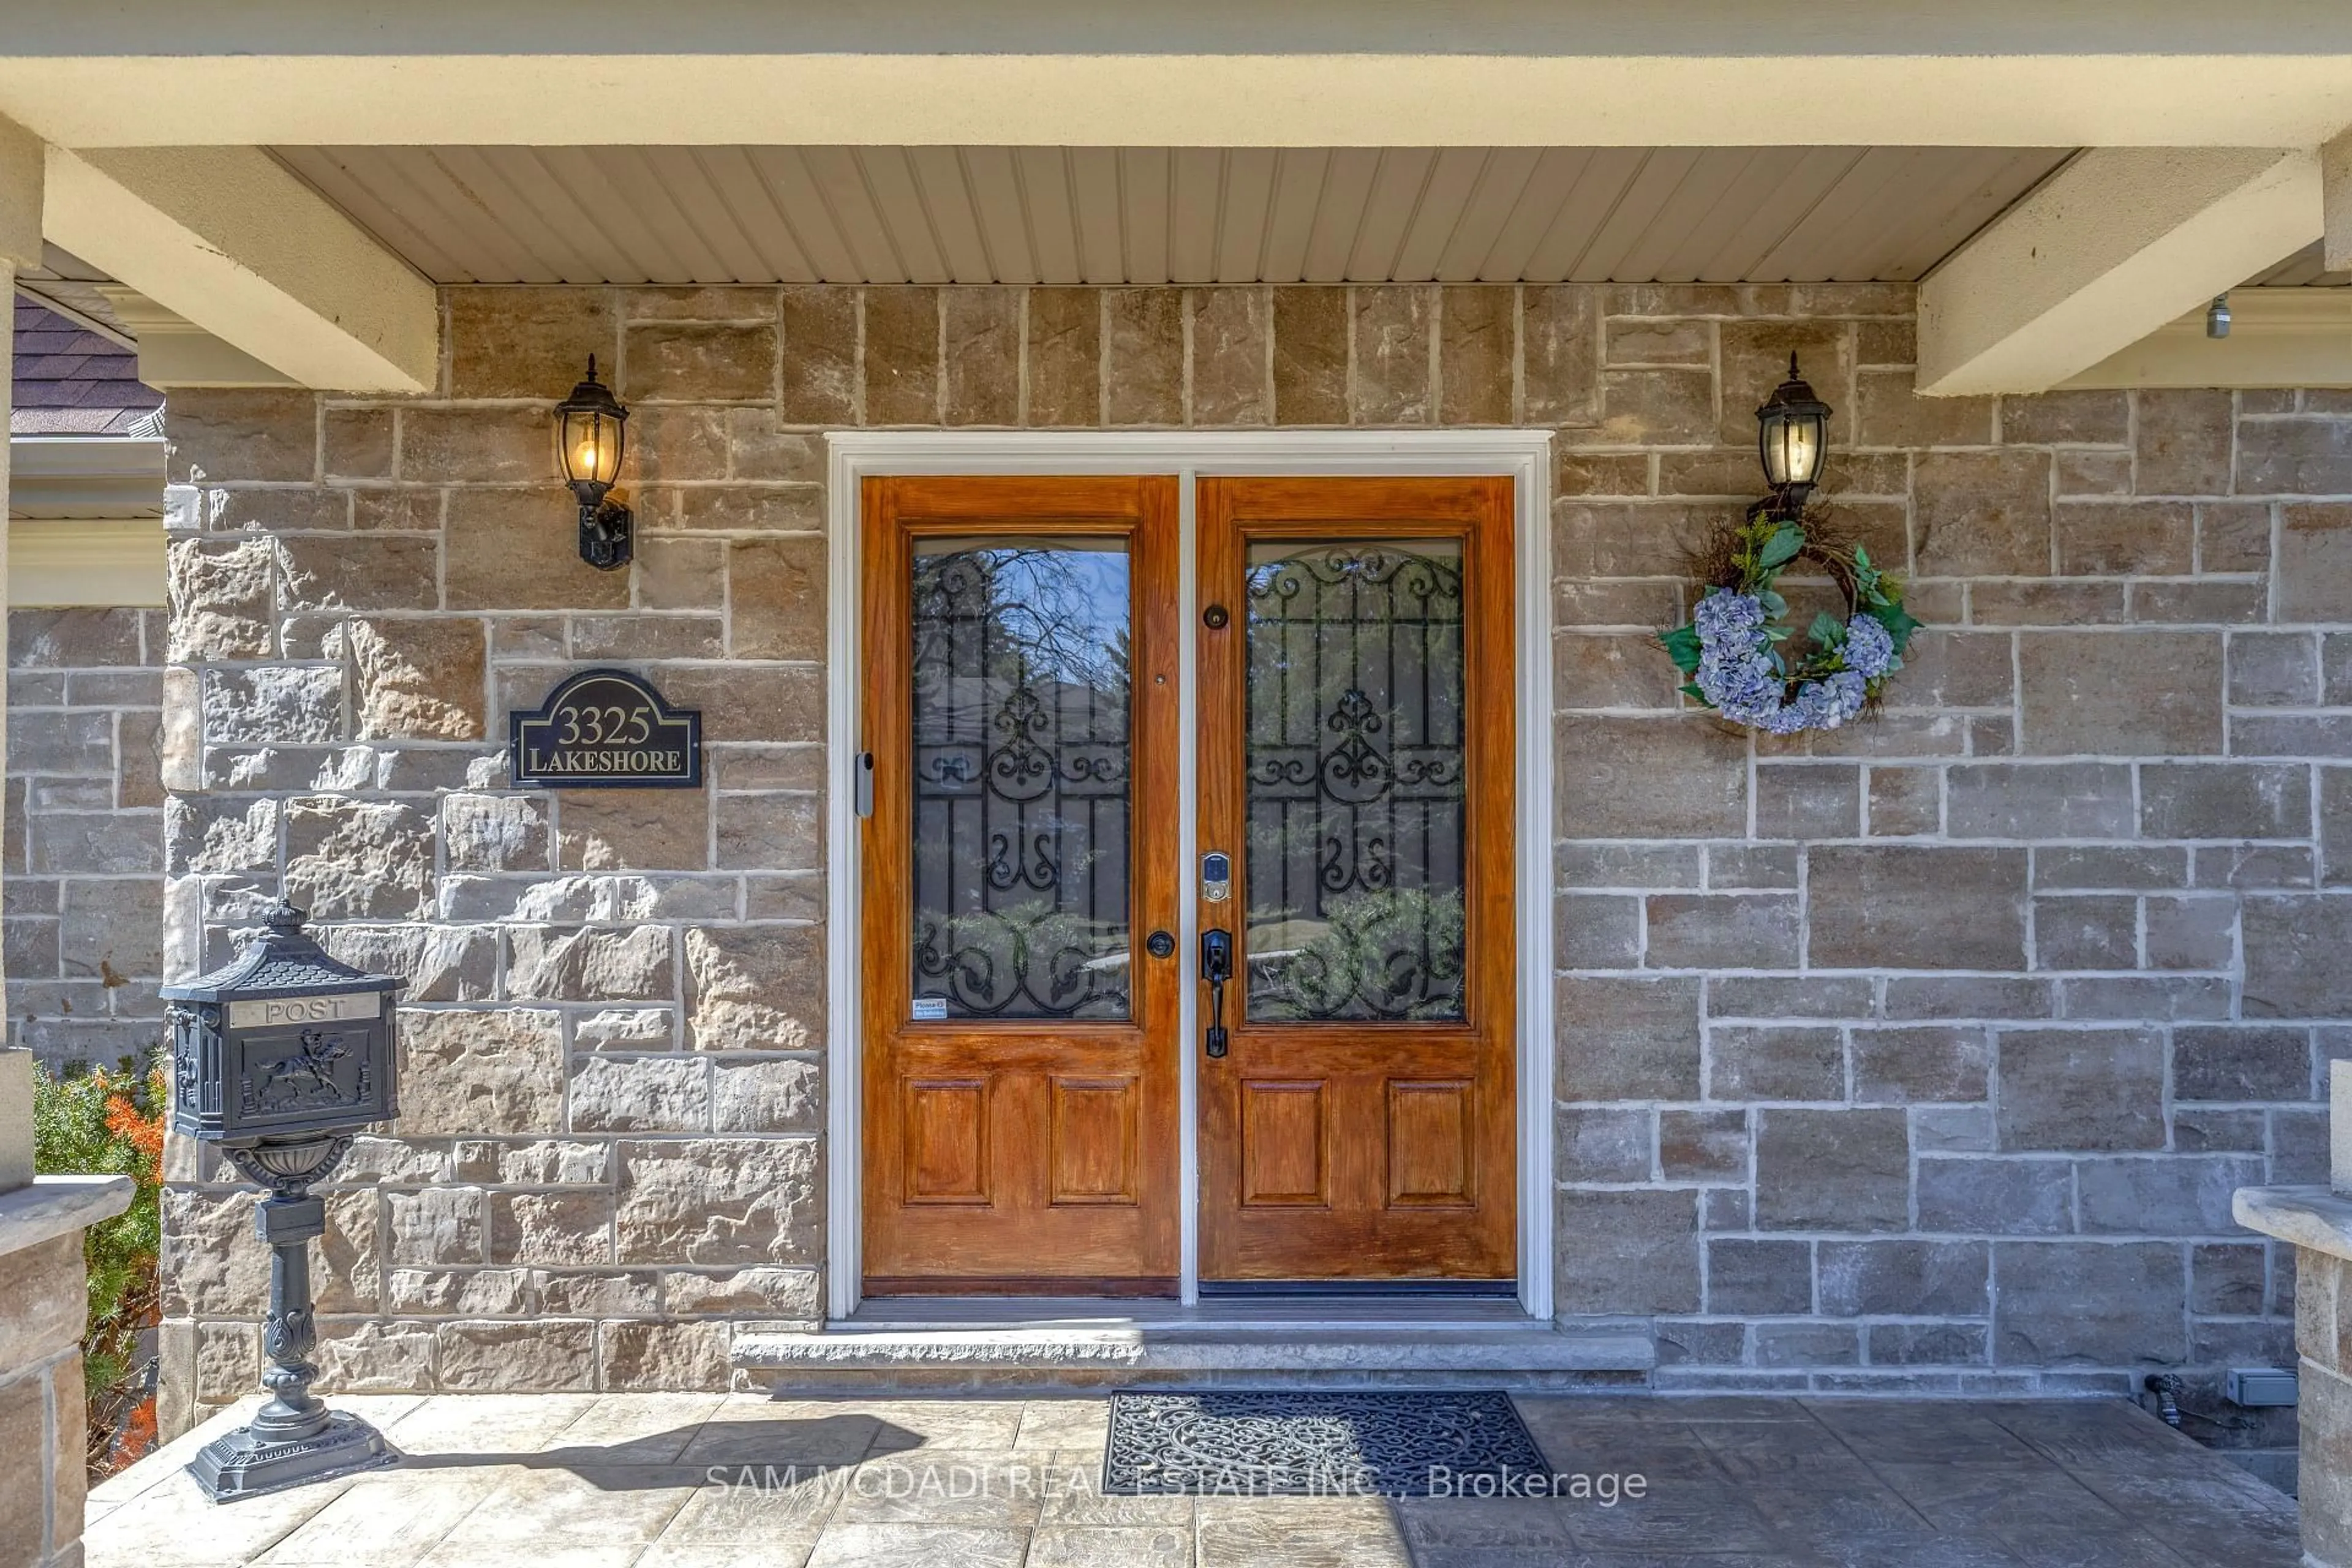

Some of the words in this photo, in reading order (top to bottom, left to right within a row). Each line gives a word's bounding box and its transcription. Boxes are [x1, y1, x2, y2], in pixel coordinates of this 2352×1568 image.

[558, 706, 652, 745] 3325
[529, 748, 681, 772] LAKESHORE
[265, 999, 347, 1024] POST
